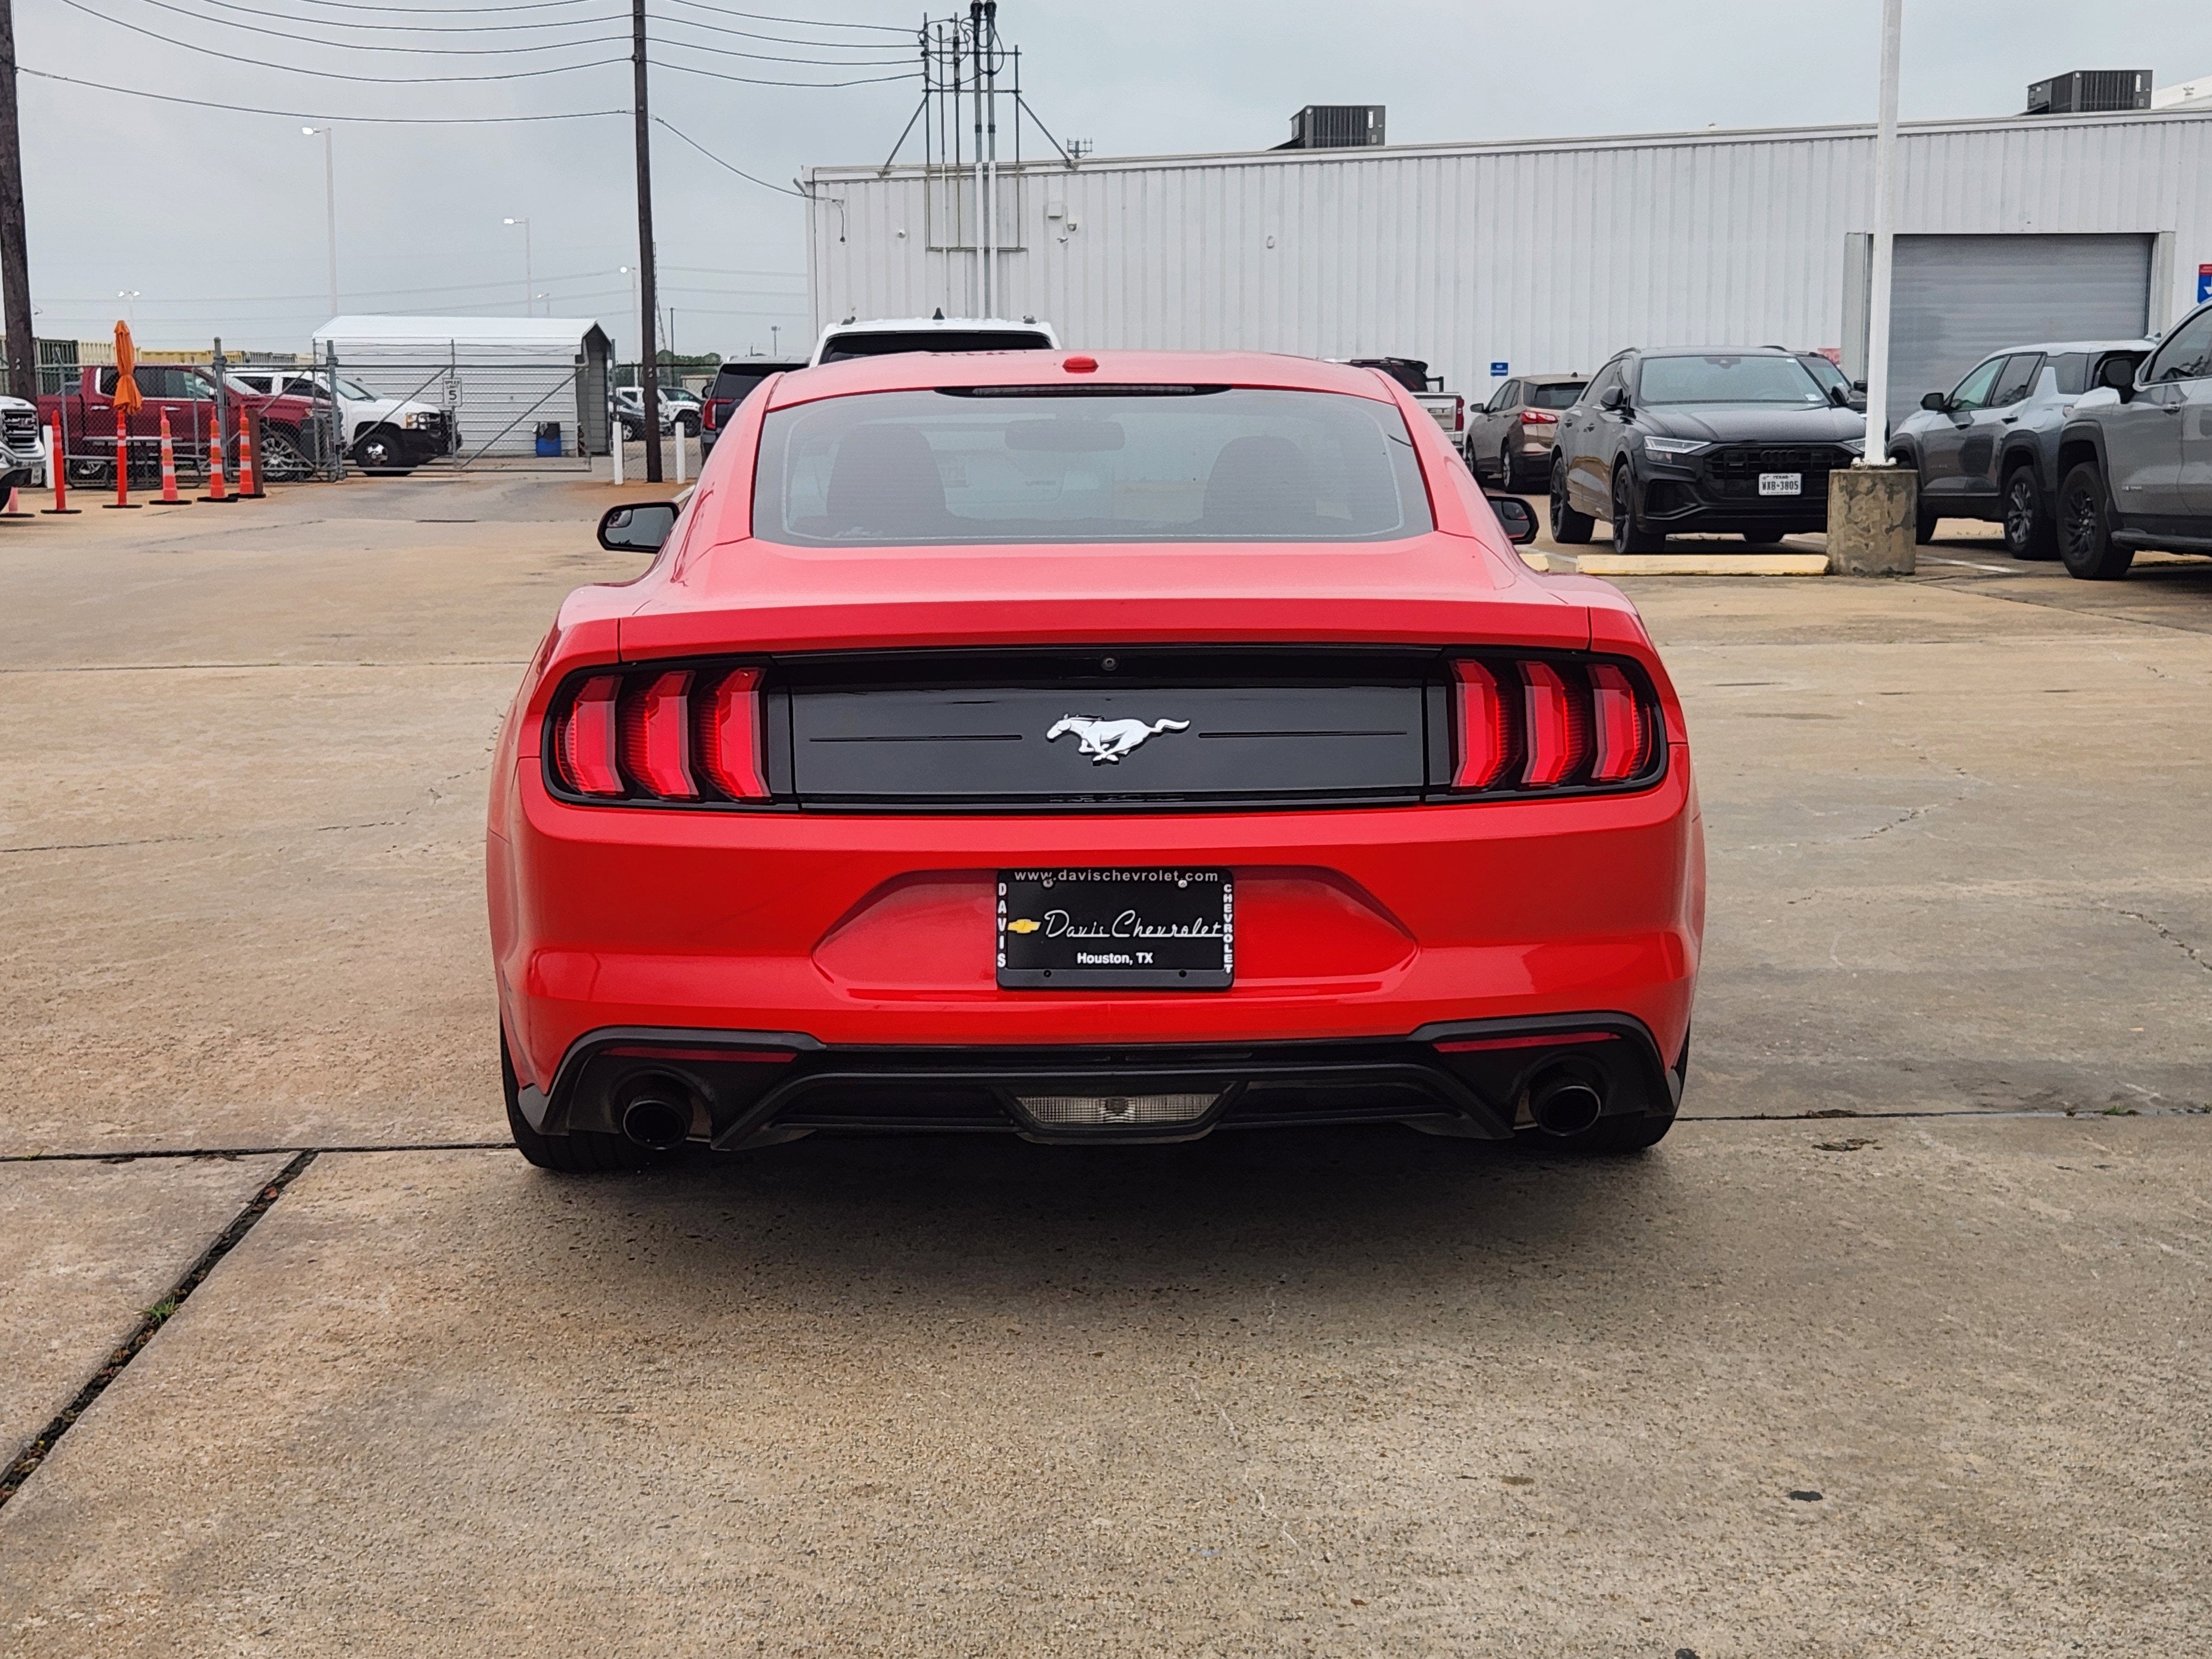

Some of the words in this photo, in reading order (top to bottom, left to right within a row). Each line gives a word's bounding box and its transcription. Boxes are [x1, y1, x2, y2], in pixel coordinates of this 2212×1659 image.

[449, 390, 457, 400] 5
[1014, 869, 1218, 881] www.davischevrolet.com
[998, 882, 1006, 968] DAVIS
[1044, 909, 1110, 938] Davis
[1111, 909, 1223, 938] Chevrolet
[1223, 884, 1233, 974] CHEVROLET
[1077, 952, 1133, 966] Houston,
[1136, 952, 1153, 964] TX
